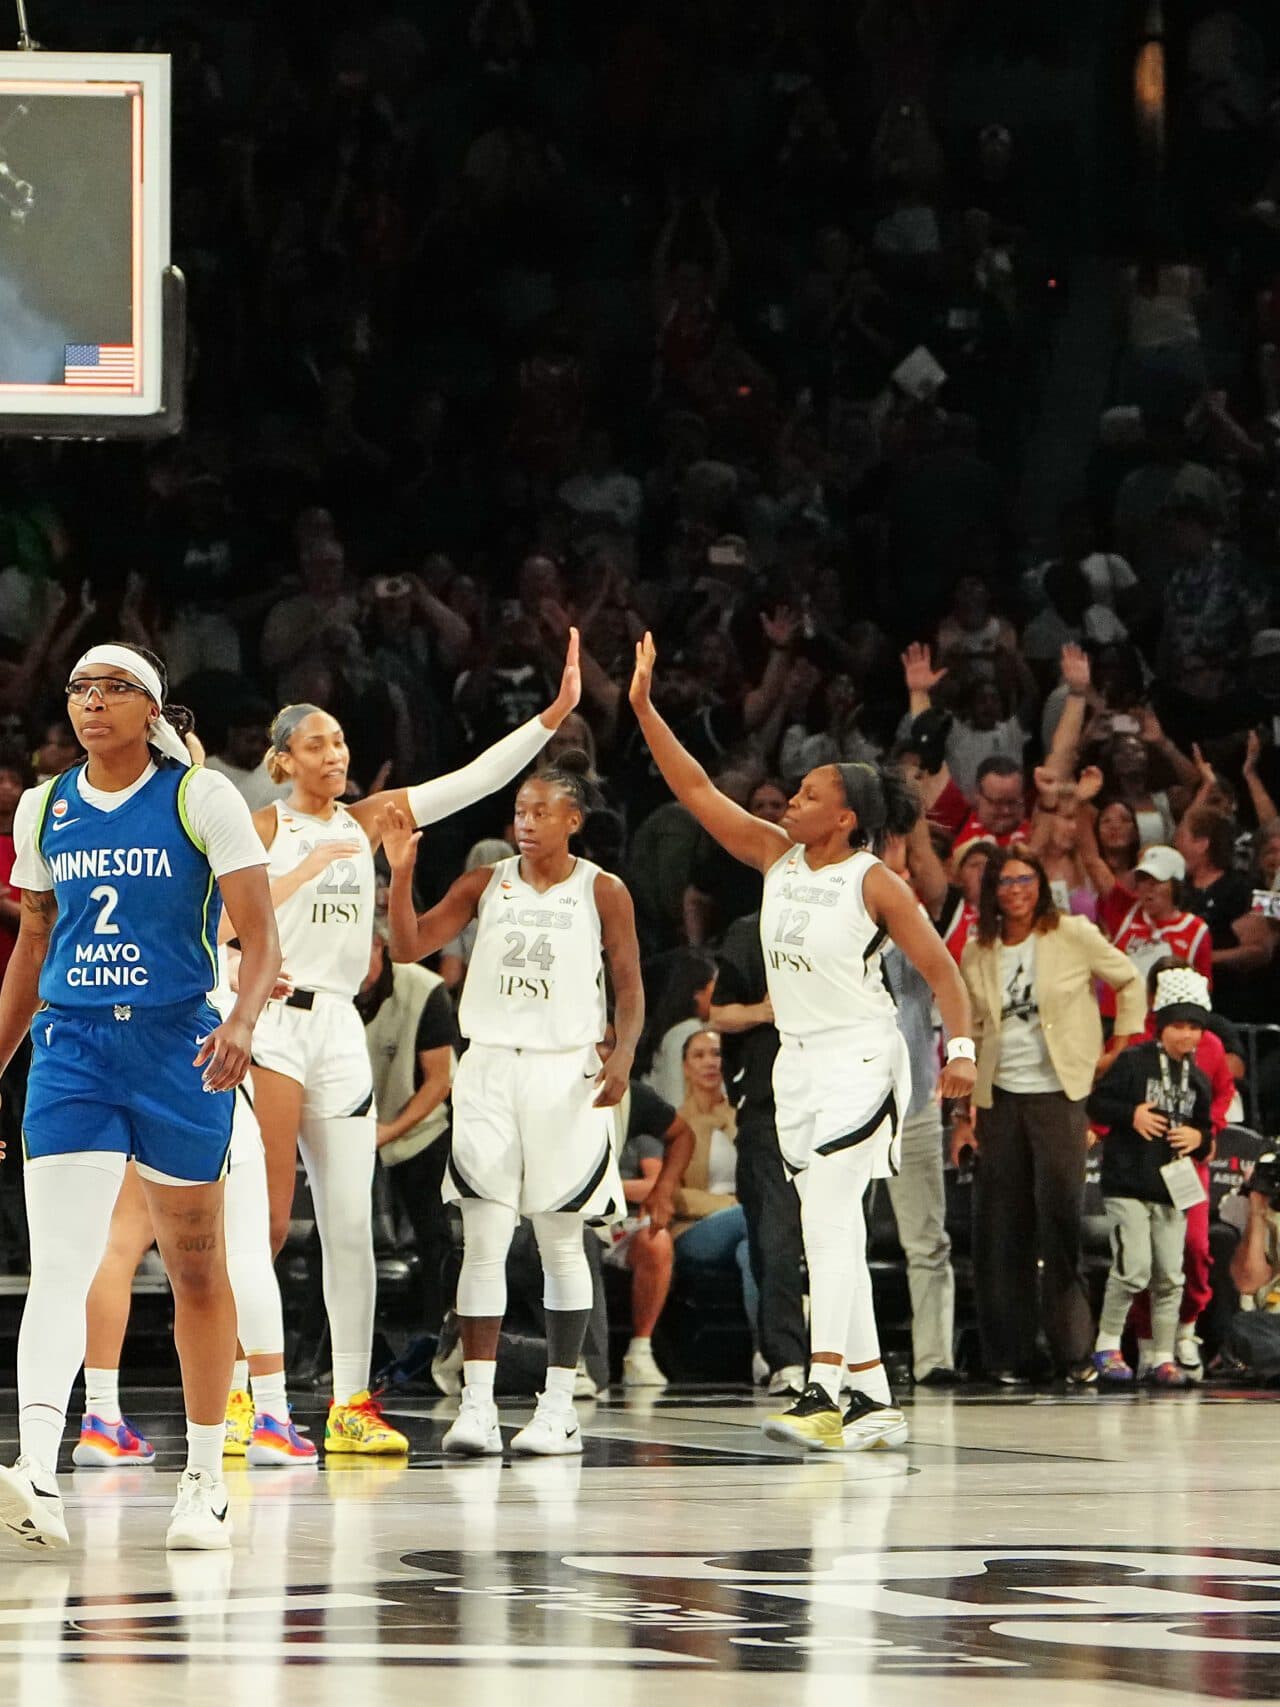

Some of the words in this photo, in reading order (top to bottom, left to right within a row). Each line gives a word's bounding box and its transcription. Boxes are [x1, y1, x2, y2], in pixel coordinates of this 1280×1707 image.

[50, 848, 172, 883] MINNESOTA
[775, 881, 840, 907] ACES
[89, 885, 120, 935] 2
[311, 902, 362, 924] IPSY
[497, 907, 574, 930] ACES
[774, 908, 810, 946] 12
[75, 943, 141, 964] MAYO
[502, 931, 555, 971] 24
[769, 949, 812, 973] IPSY
[66, 967, 149, 987] CLINIC
[499, 974, 556, 1000] IPSY
